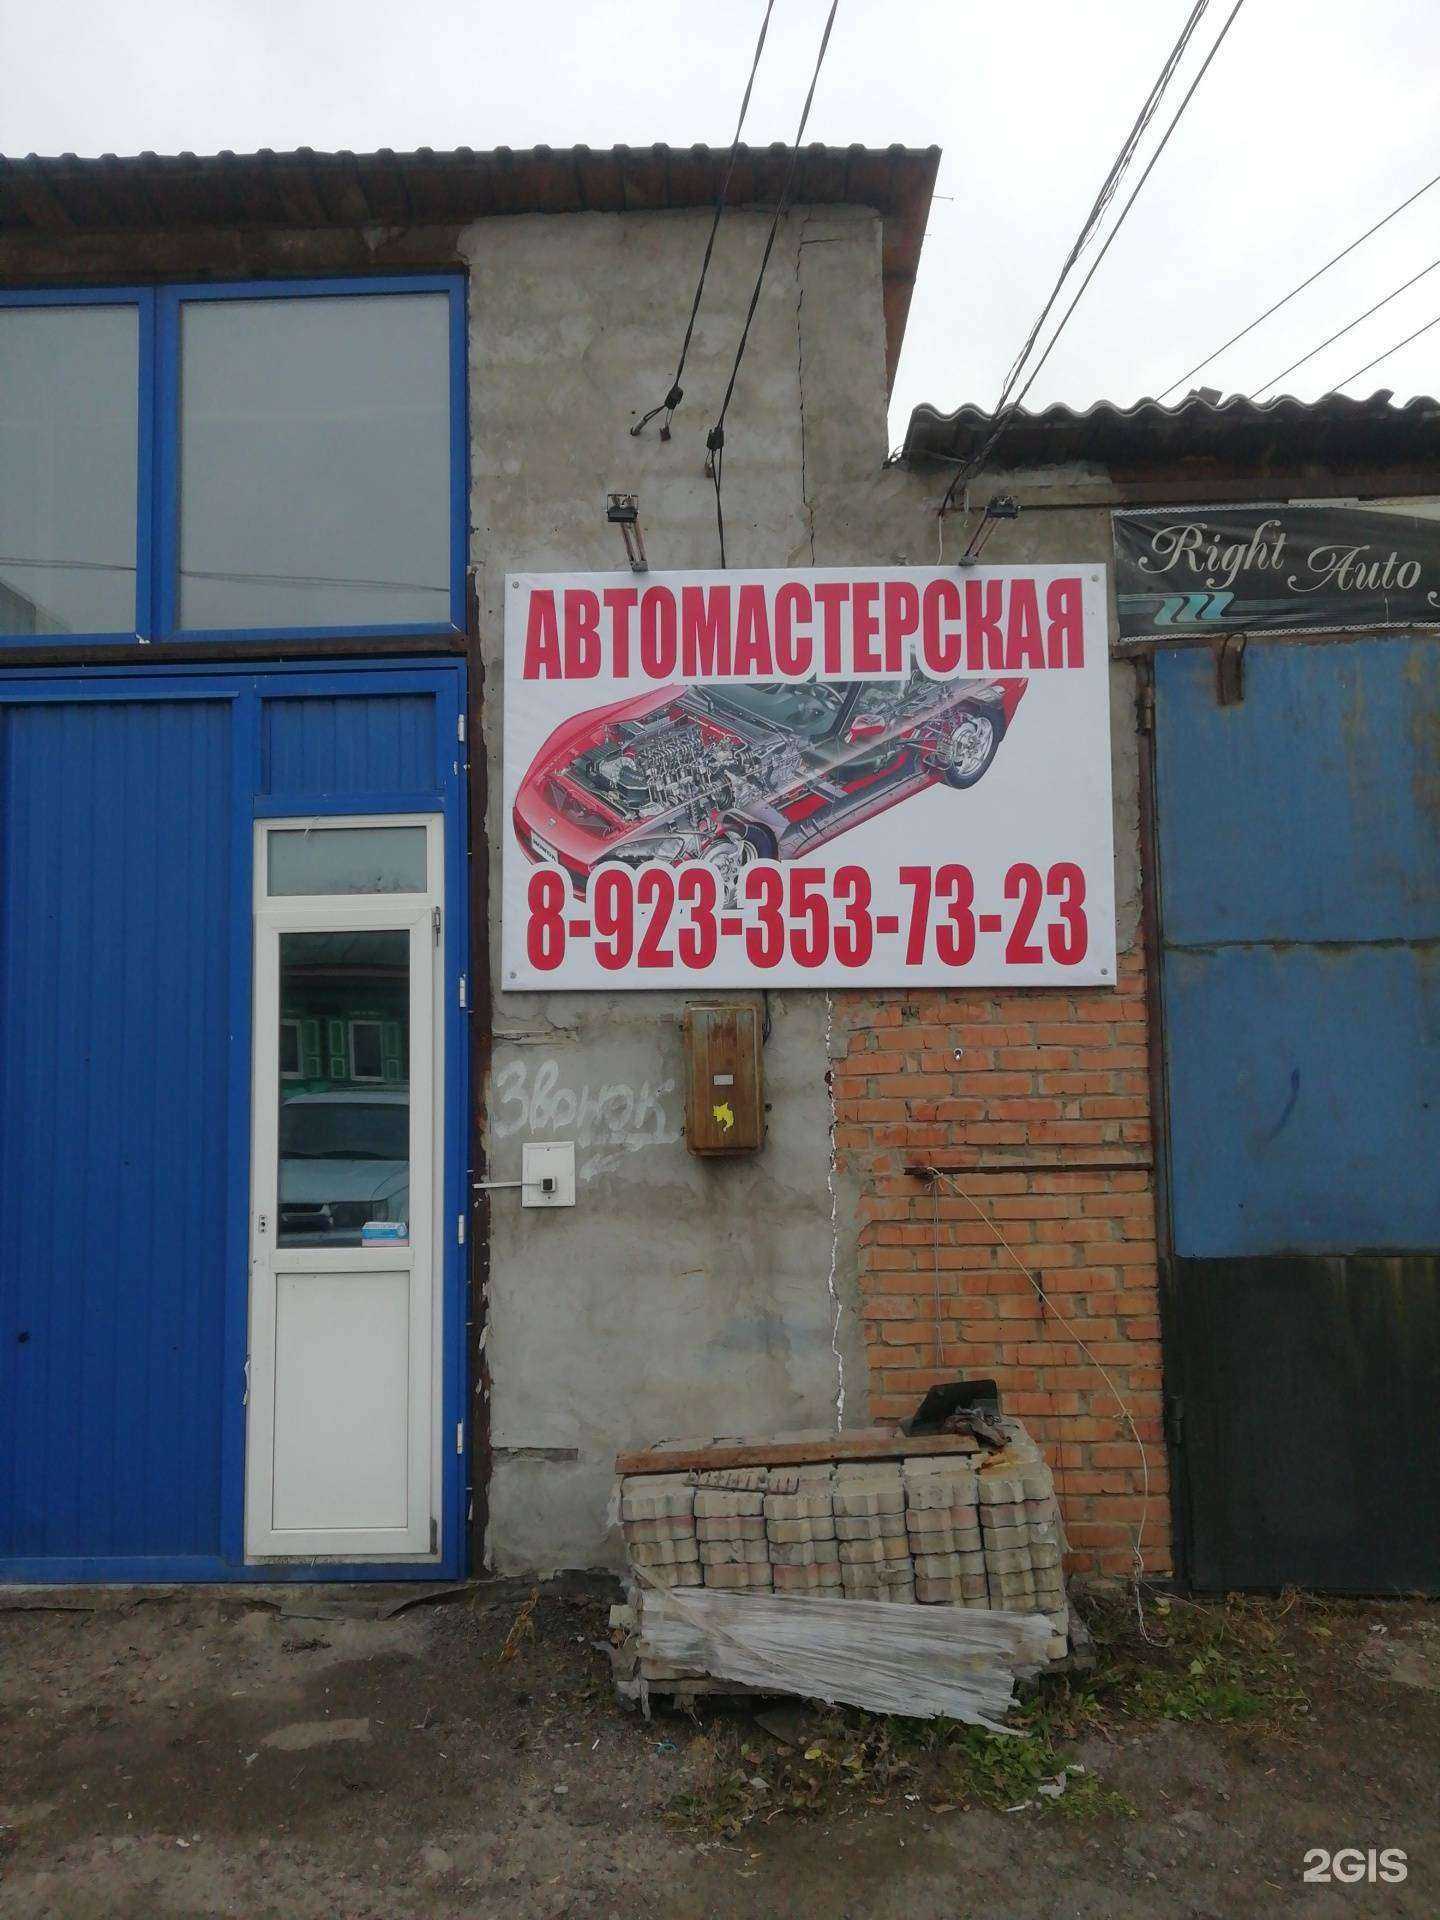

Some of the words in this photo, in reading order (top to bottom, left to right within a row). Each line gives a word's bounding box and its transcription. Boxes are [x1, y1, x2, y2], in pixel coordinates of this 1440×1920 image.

[1138, 519, 1287, 589] Right
[1287, 544, 1422, 592] Auto
[523, 578, 1085, 680] АВТОМАСТЕРСКАЯ
[526, 862, 1088, 971] 8-923-353-73-23
